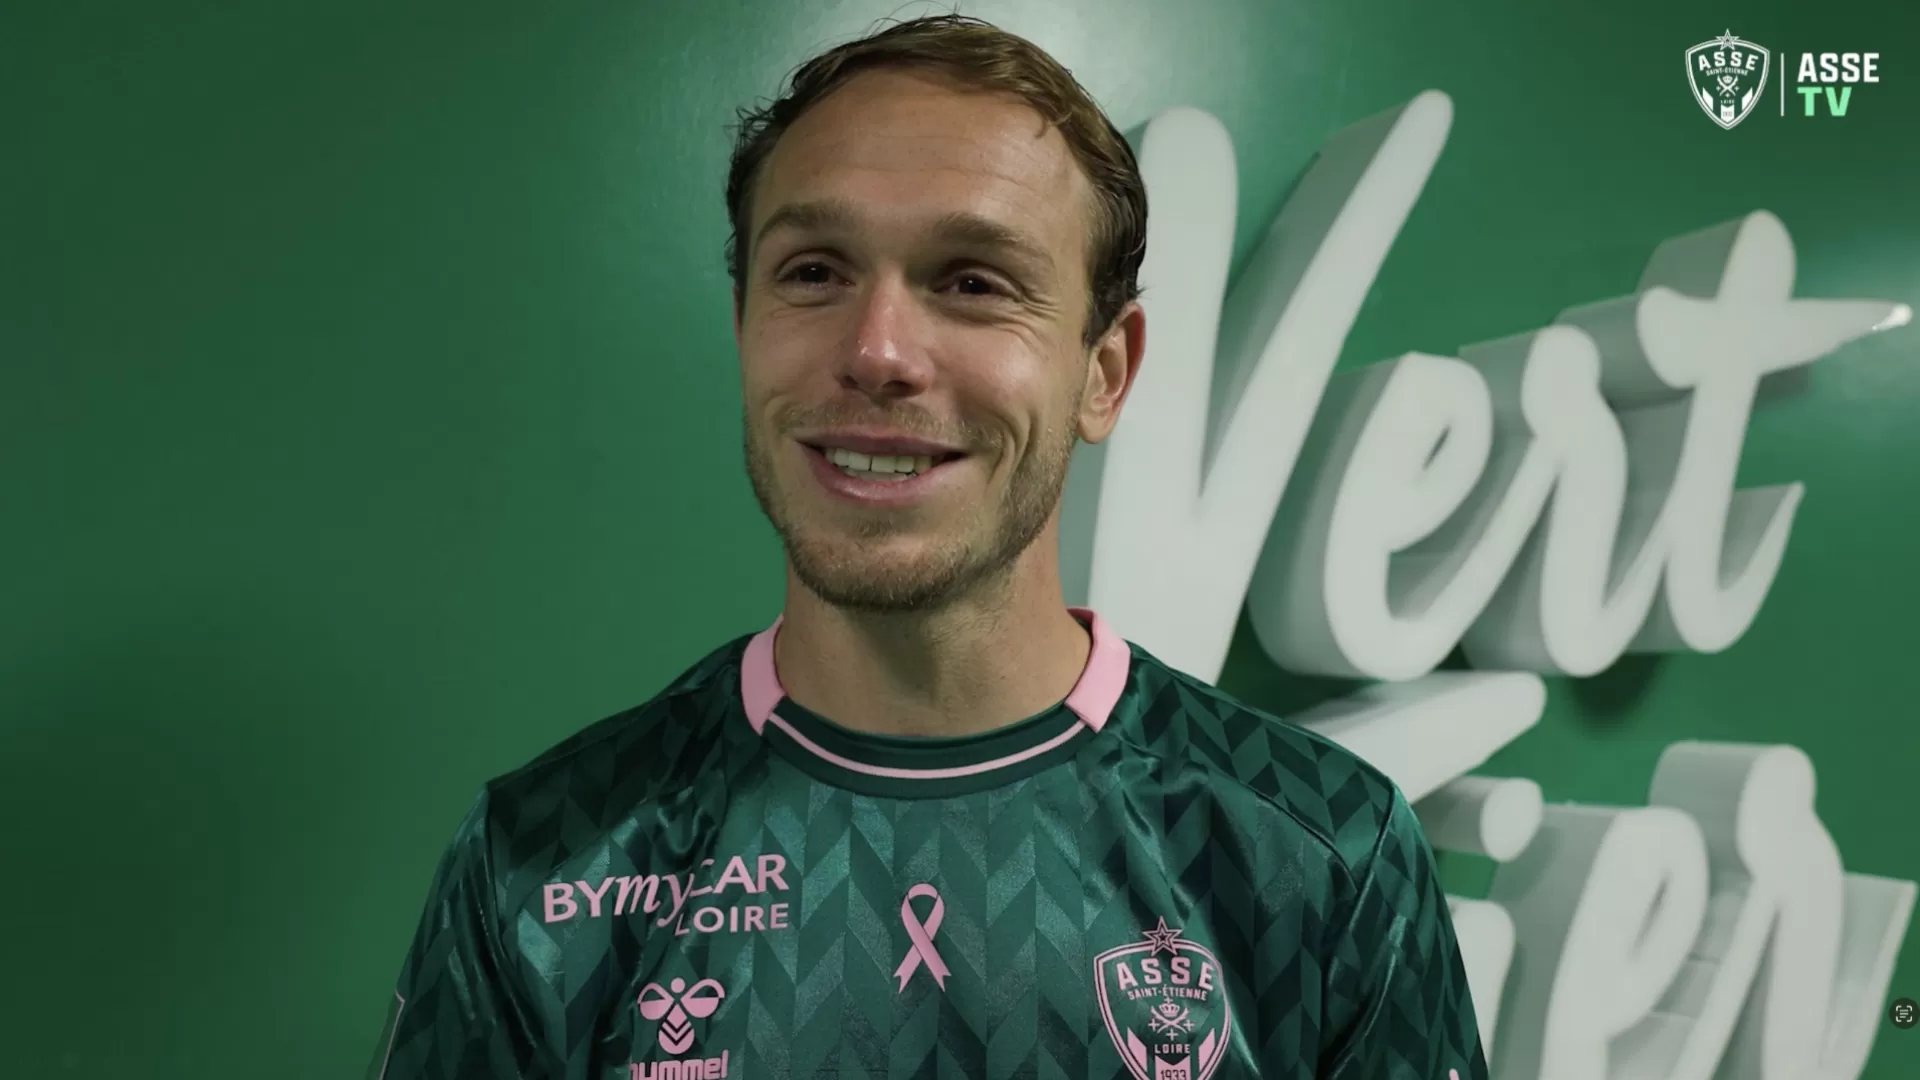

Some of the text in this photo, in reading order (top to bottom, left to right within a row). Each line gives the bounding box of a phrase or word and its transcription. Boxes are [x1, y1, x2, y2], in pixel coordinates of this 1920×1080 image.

[1087, 89, 1913, 687] Vert
[674, 902, 790, 937] LOIRE
[1115, 956, 1216, 992] ASSE
[1127, 984, 1208, 1001] SAINT-ÉTIENNE
[1154, 1043, 1191, 1055] LOIRE
